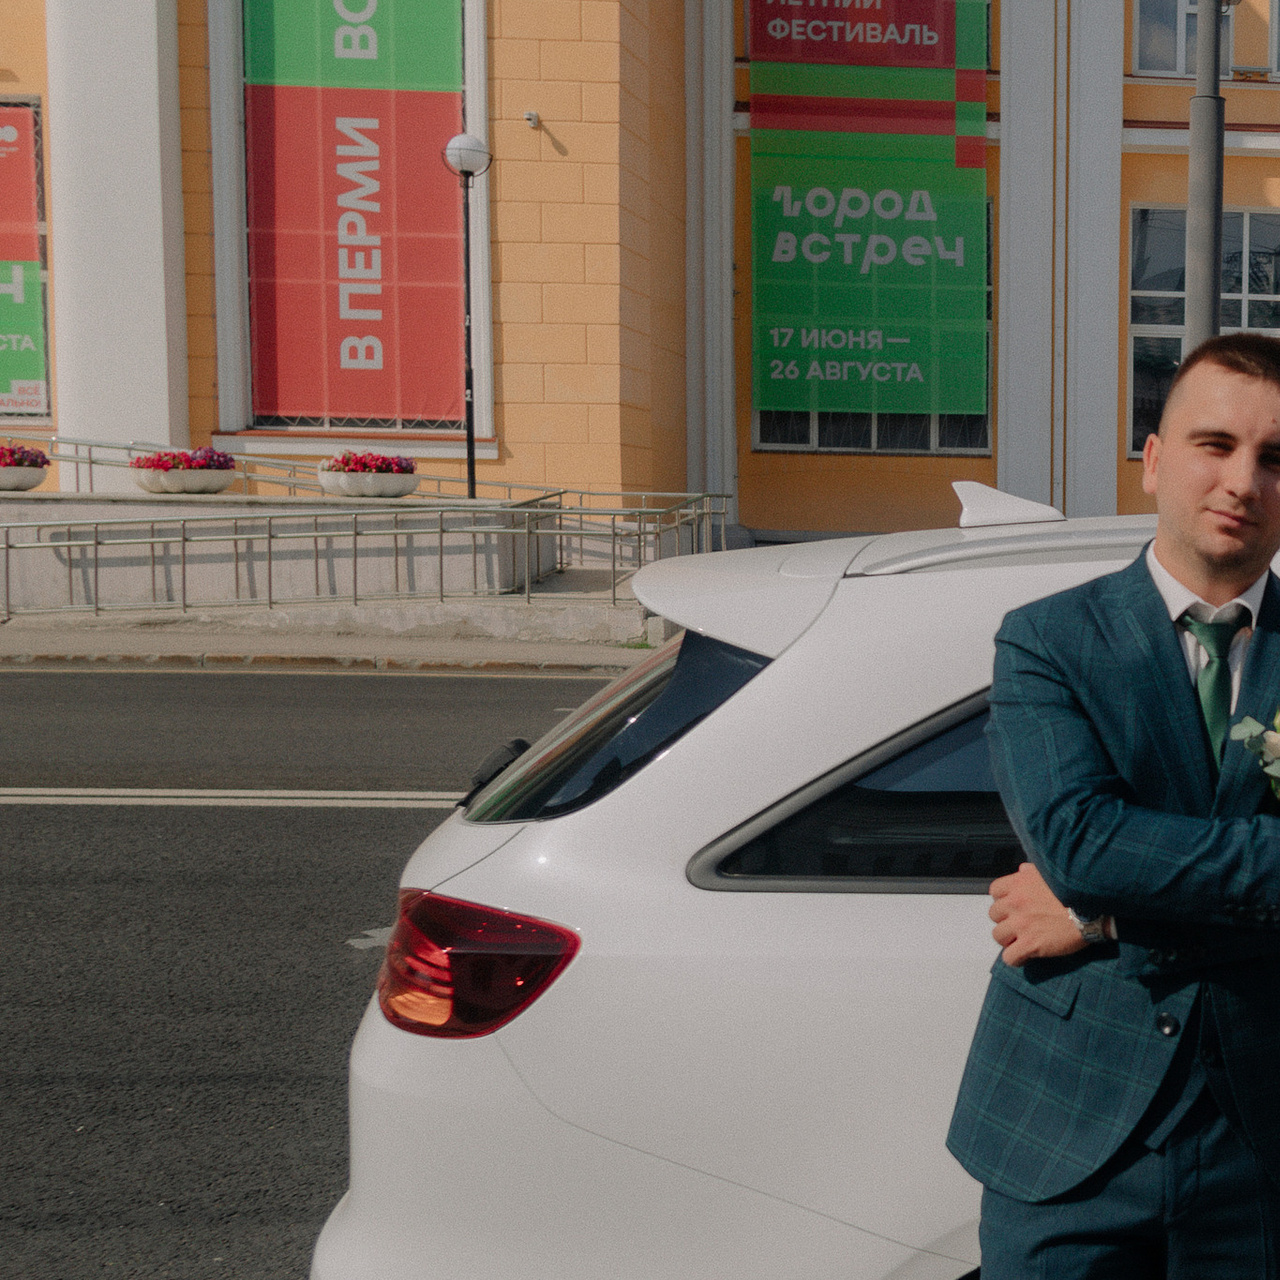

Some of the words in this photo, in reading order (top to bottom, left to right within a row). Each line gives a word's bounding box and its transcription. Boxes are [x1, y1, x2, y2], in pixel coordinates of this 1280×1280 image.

[766, 18, 939, 45] ФЕСТИВАЛЬ
[335, 117, 383, 320] ПЕРМИ
[769, 327, 794, 348] 17
[340, 335, 383, 369] В
[769, 359, 799, 380] 26
[805, 360, 924, 382] АВГУСТА
